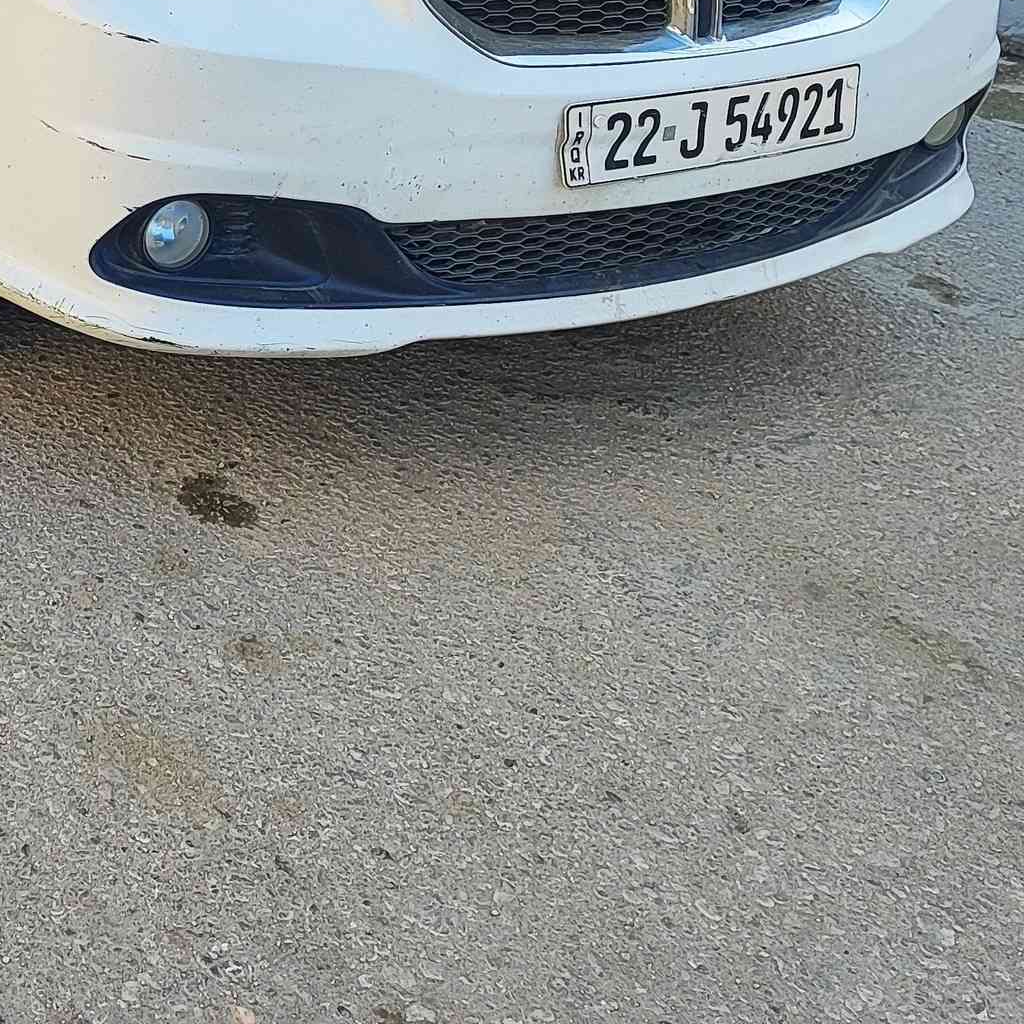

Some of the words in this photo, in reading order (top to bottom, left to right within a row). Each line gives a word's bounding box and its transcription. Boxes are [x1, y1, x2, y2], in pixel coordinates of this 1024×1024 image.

[604, 108, 661, 171] 22
[679, 102, 708, 159] J
[725, 78, 845, 152] 54921
[569, 166, 585, 181] KR
